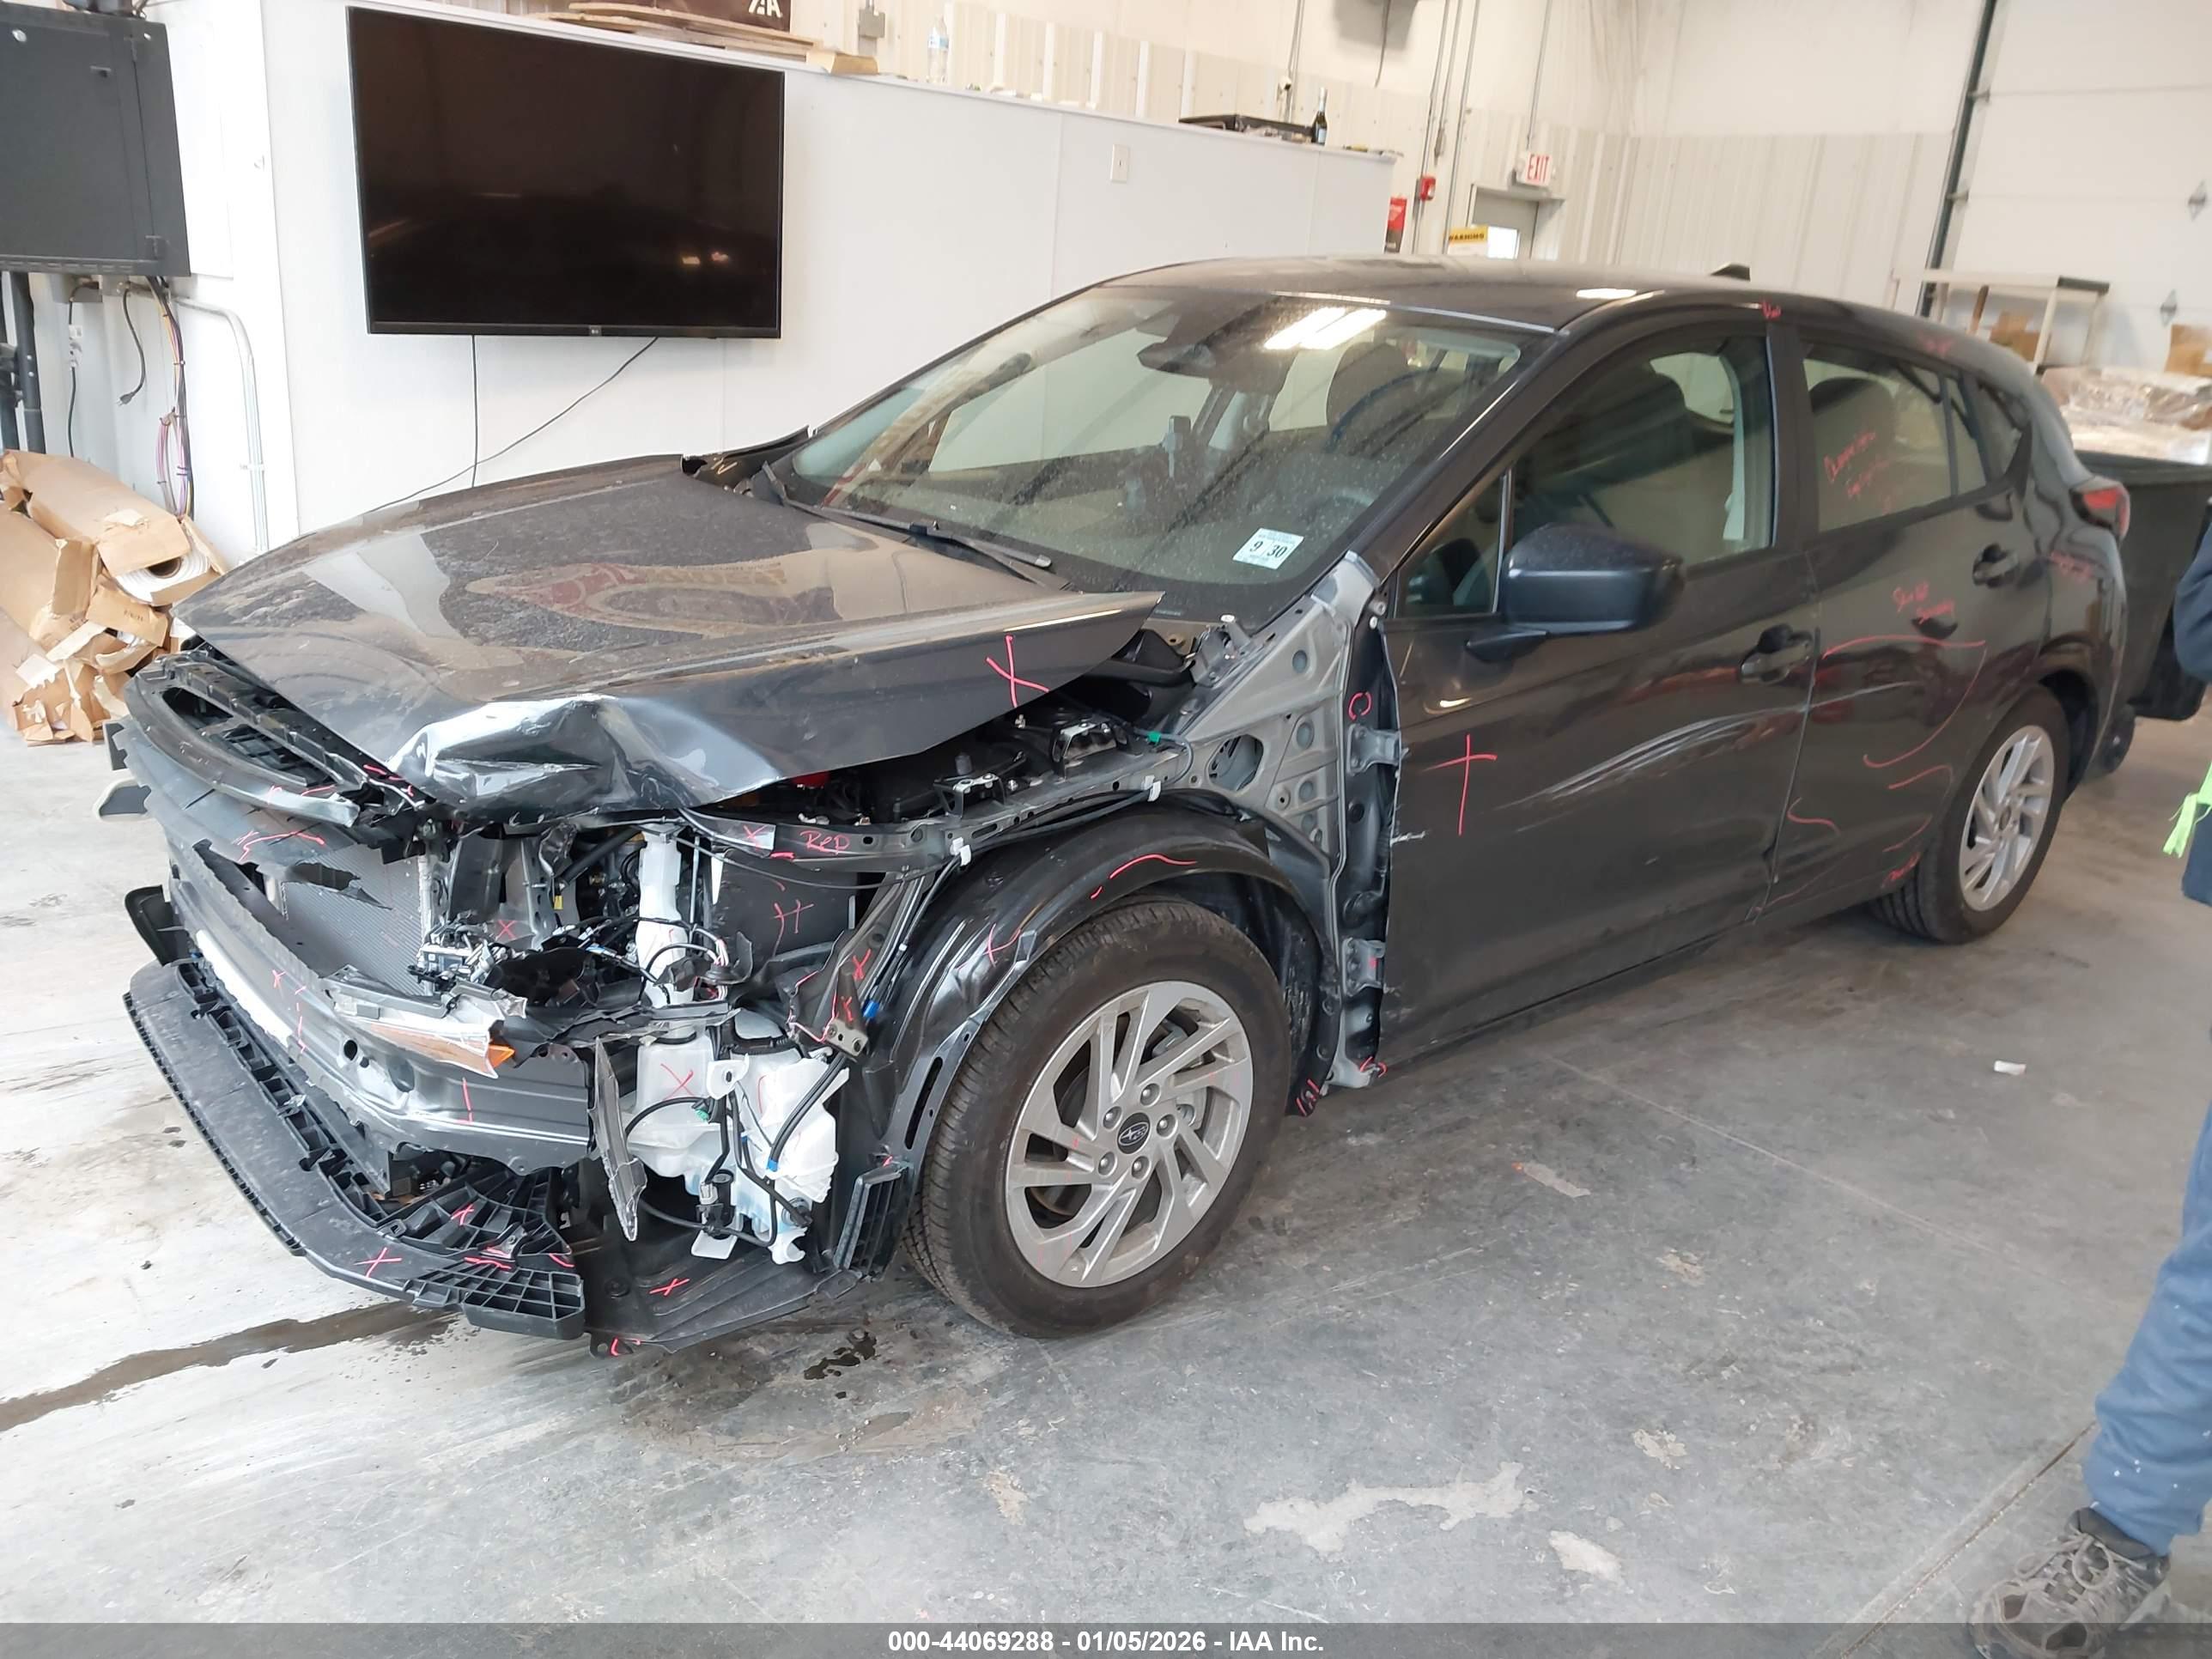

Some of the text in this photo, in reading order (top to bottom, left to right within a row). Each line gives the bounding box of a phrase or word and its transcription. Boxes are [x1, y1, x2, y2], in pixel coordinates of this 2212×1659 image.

[1527, 154, 1550, 183] EXIT
[1249, 540, 1288, 558] 9 30
